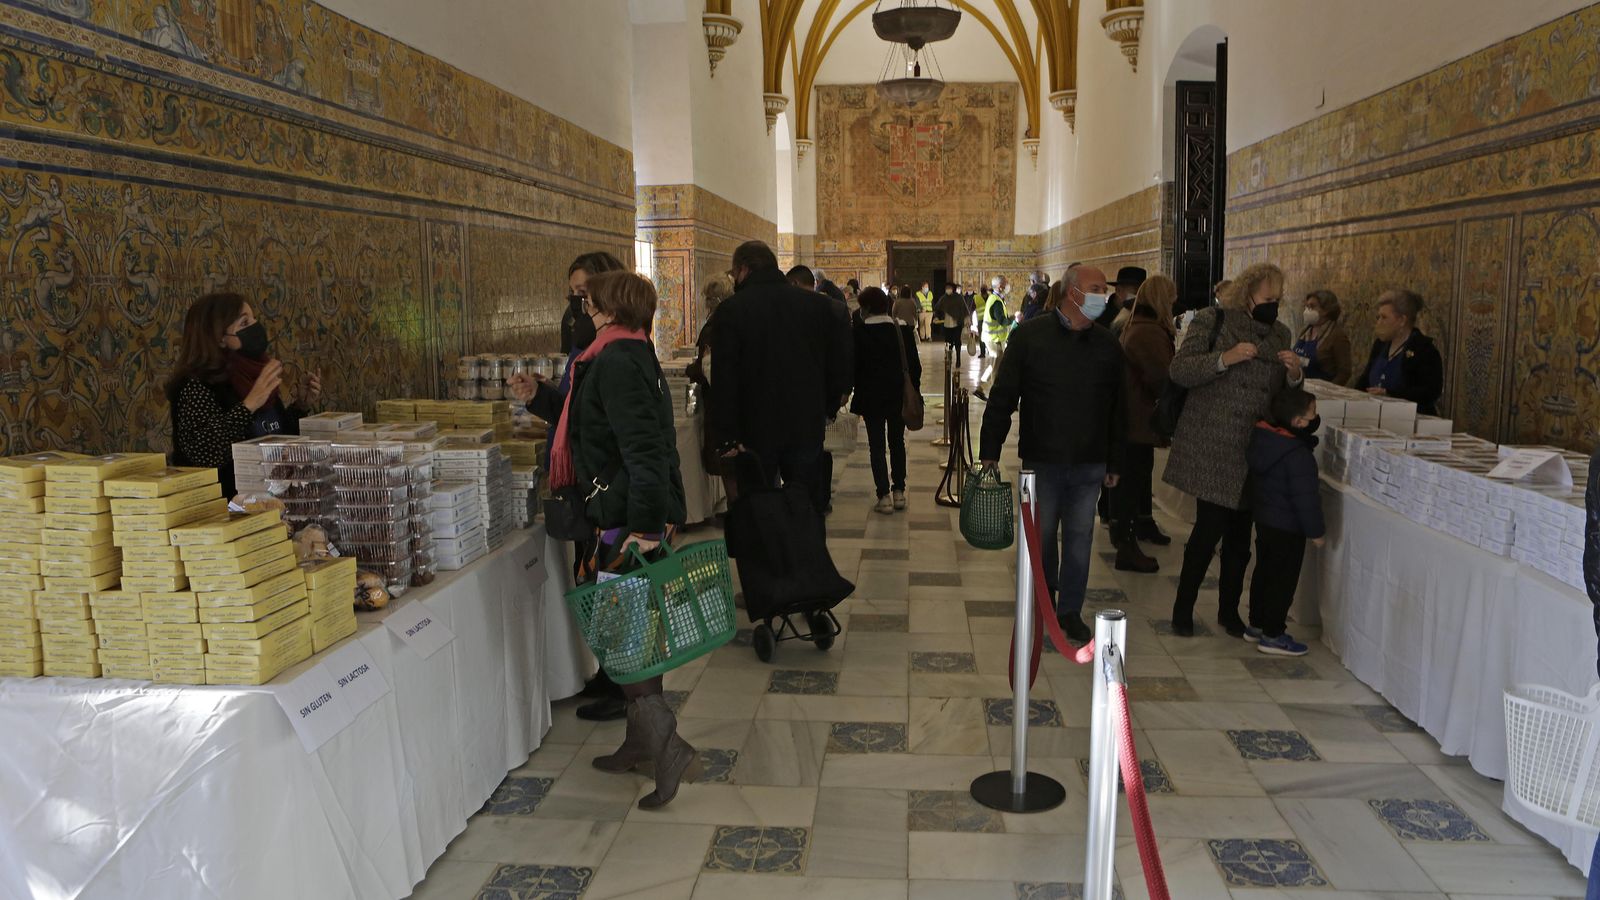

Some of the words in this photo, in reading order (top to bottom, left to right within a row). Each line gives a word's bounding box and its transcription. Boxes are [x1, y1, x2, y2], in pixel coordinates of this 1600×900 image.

[405, 627, 416, 637] SIN
[415, 617, 432, 632] LACTOSA
[338, 676, 349, 688] SIN
[347, 663, 370, 682] LACTOSA
[299, 705, 311, 718] SIN
[310, 691, 332, 711] GLUTEN
